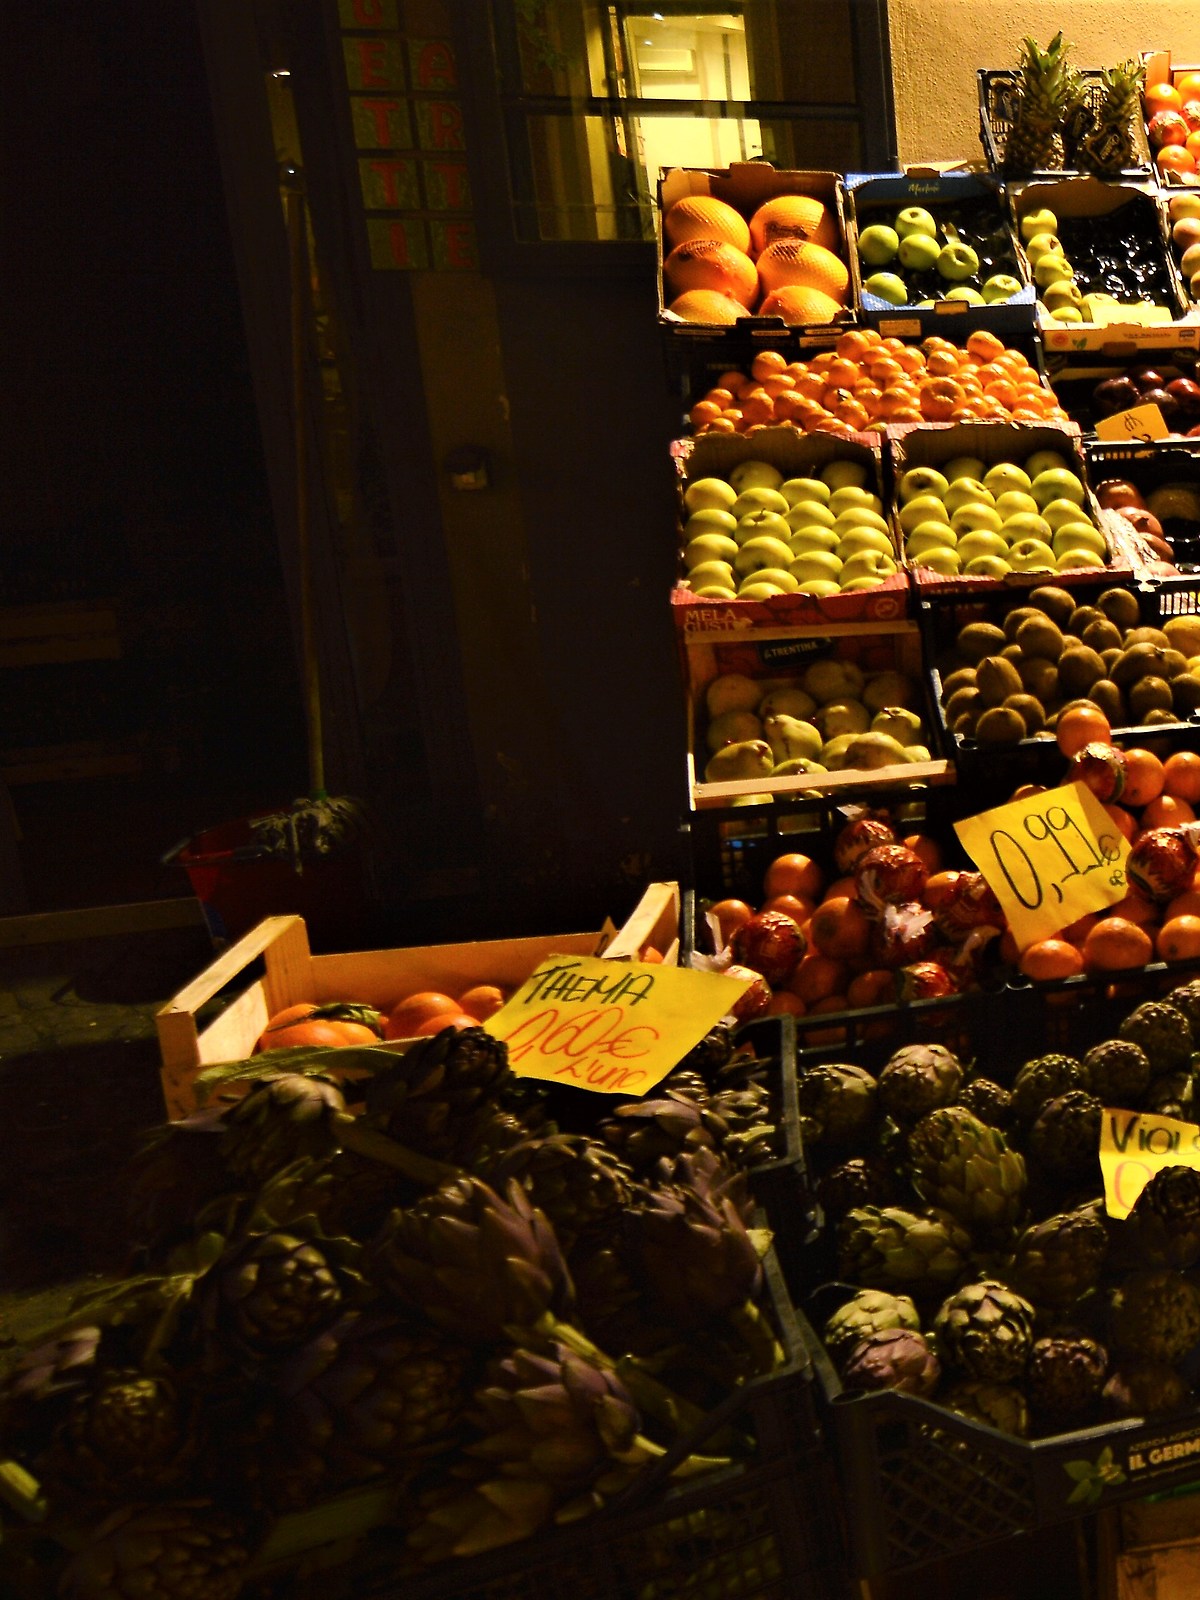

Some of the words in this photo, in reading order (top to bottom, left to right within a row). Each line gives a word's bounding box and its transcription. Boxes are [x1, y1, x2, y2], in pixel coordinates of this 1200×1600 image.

[419, 43, 475, 268] ARTE
[685, 608, 736, 622] MELA
[525, 962, 655, 1006] THEMA
[1129, 1453, 1147, 1471] IL
